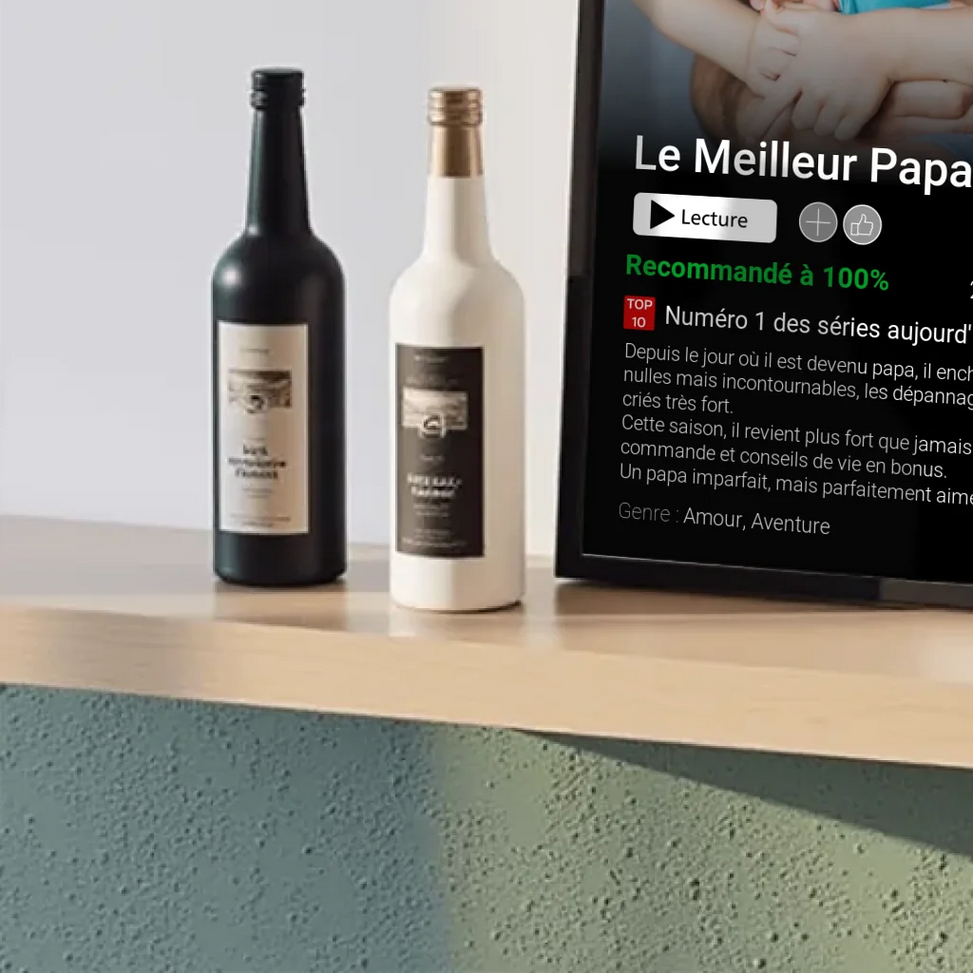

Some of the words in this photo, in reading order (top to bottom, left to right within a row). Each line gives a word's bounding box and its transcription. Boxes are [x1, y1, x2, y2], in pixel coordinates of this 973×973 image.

[636, 135, 680, 171] Le
[695, 138, 857, 181] Meilleur
[871, 147, 971, 195] Papa
[681, 209, 748, 228] Lecture
[627, 254, 792, 284] Recommandé
[800, 264, 813, 286] à
[824, 267, 889, 291] 100%
[627, 298, 653, 310] TOP
[632, 317, 646, 328] 10
[666, 305, 748, 329] Numéro
[756, 311, 763, 331] 1
[774, 312, 810, 333] des
[818, 315, 880, 338] séries
[625, 342, 680, 364] Depuis
[685, 346, 699, 363] le
[701, 348, 735, 368] jour
[739, 351, 759, 367] où
[764, 352, 772, 368] il
[777, 355, 802, 370] est
[807, 355, 867, 374] devenu
[872, 363, 918, 381] papa,
[923, 362, 931, 379] il
[624, 367, 671, 385] nulles
[676, 373, 717, 388] mais
[722, 376, 859, 400] incontournables,
[865, 383, 888, 400] les
[623, 391, 661, 408] criés
[665, 394, 696, 411] très
[701, 395, 733, 414] fort.
[622, 414, 665, 432] Cette
[669, 419, 727, 439] saison,
[732, 422, 739, 438] il
[745, 425, 800, 443] revient
[805, 428, 840, 447] plus
[845, 429, 874, 448] fort
[878, 436, 910, 453] que
[912, 435, 972, 456] jamais
[621, 442, 716, 461] commande
[720, 447, 735, 462] et
[740, 451, 808, 468] conseils
[813, 453, 833, 470] de
[837, 455, 862, 472] vie
[866, 460, 886, 473] en
[891, 458, 947, 478] bonus.
[620, 463, 641, 480] Un
[646, 468, 687, 487] papa
[693, 468, 771, 492] imparfait,
[776, 477, 818, 493] mais
[822, 479, 932, 503] parfaitement
[619, 502, 670, 522] Genre
[683, 507, 746, 531] Amour,
[751, 512, 830, 535] Aventure
